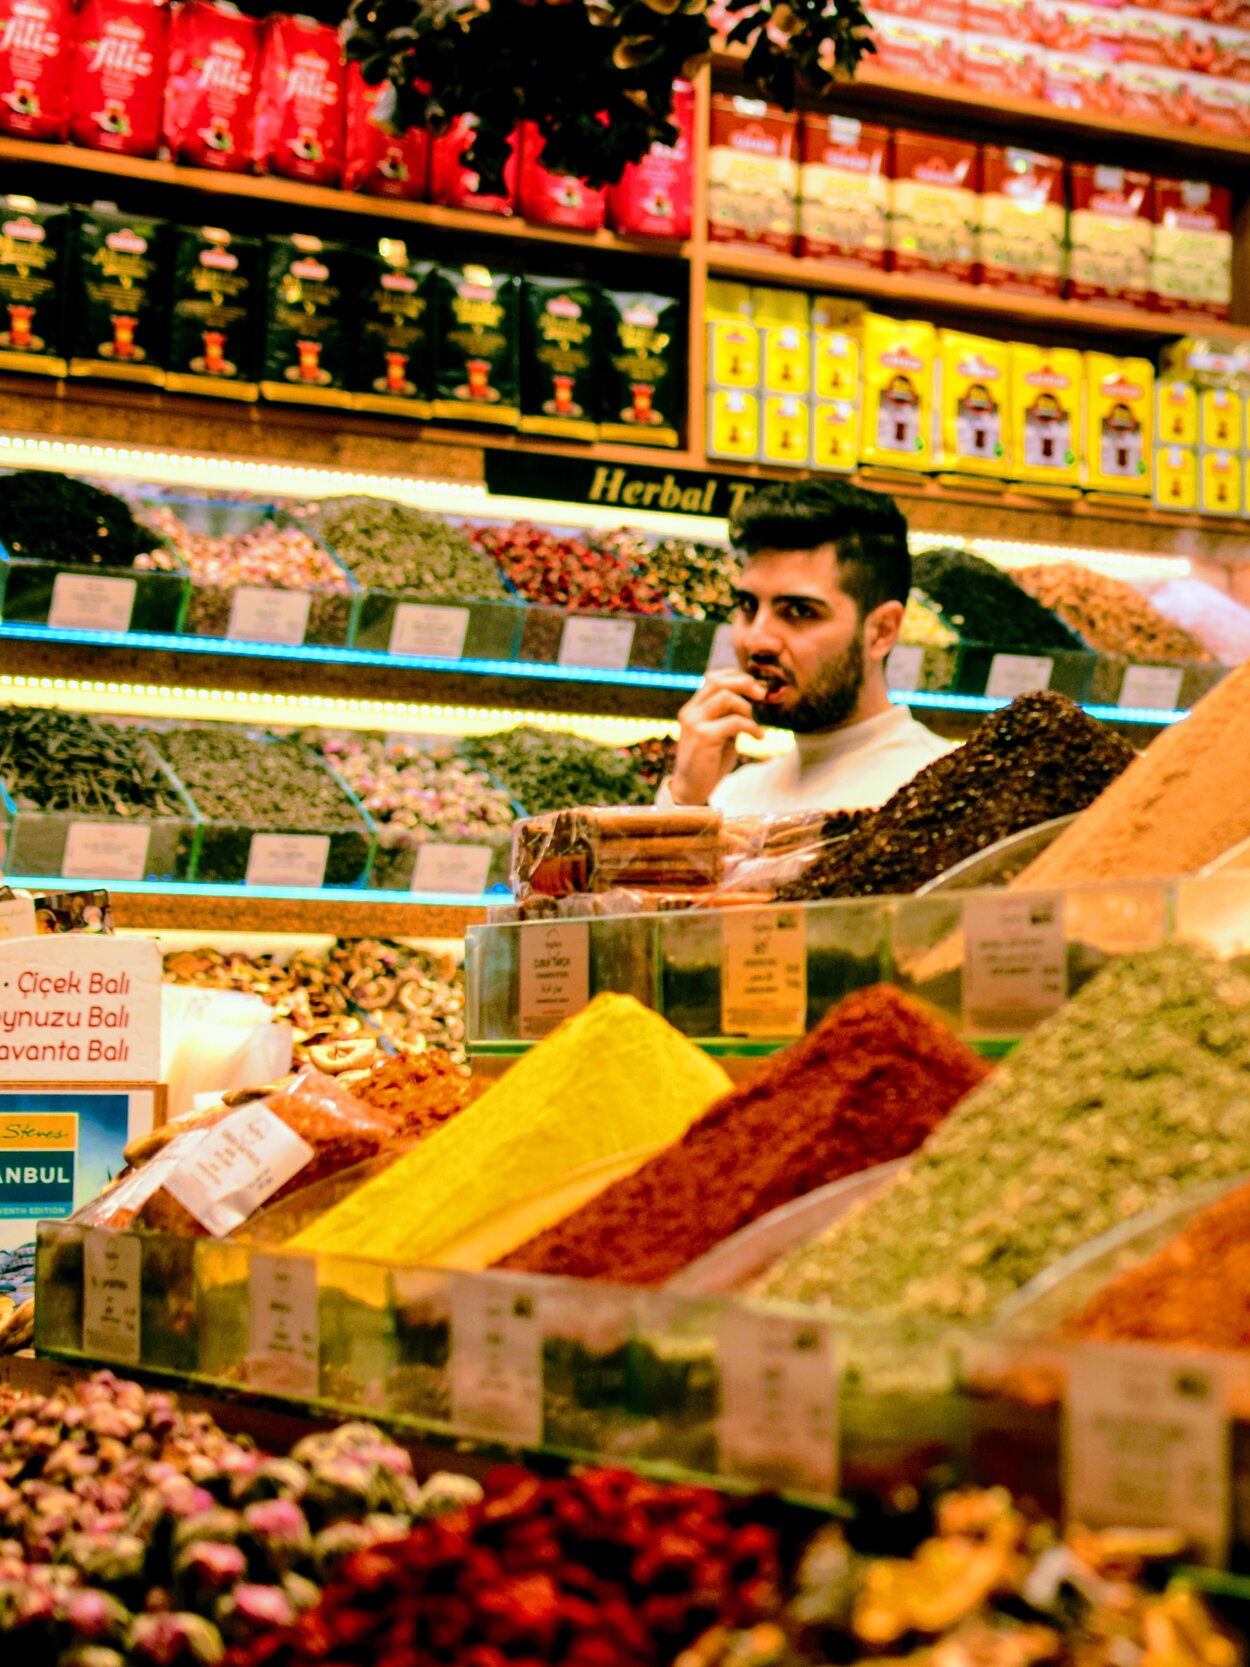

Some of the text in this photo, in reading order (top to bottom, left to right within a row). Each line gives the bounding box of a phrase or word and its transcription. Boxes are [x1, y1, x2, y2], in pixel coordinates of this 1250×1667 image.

[588, 466, 718, 513] Herbal
[18, 970, 130, 999] Çiçek Balı
[0, 1005, 129, 1033] ynuzu Balı
[88, 1038, 128, 1061] Balı
[0, 1166, 70, 1184] NBUL
